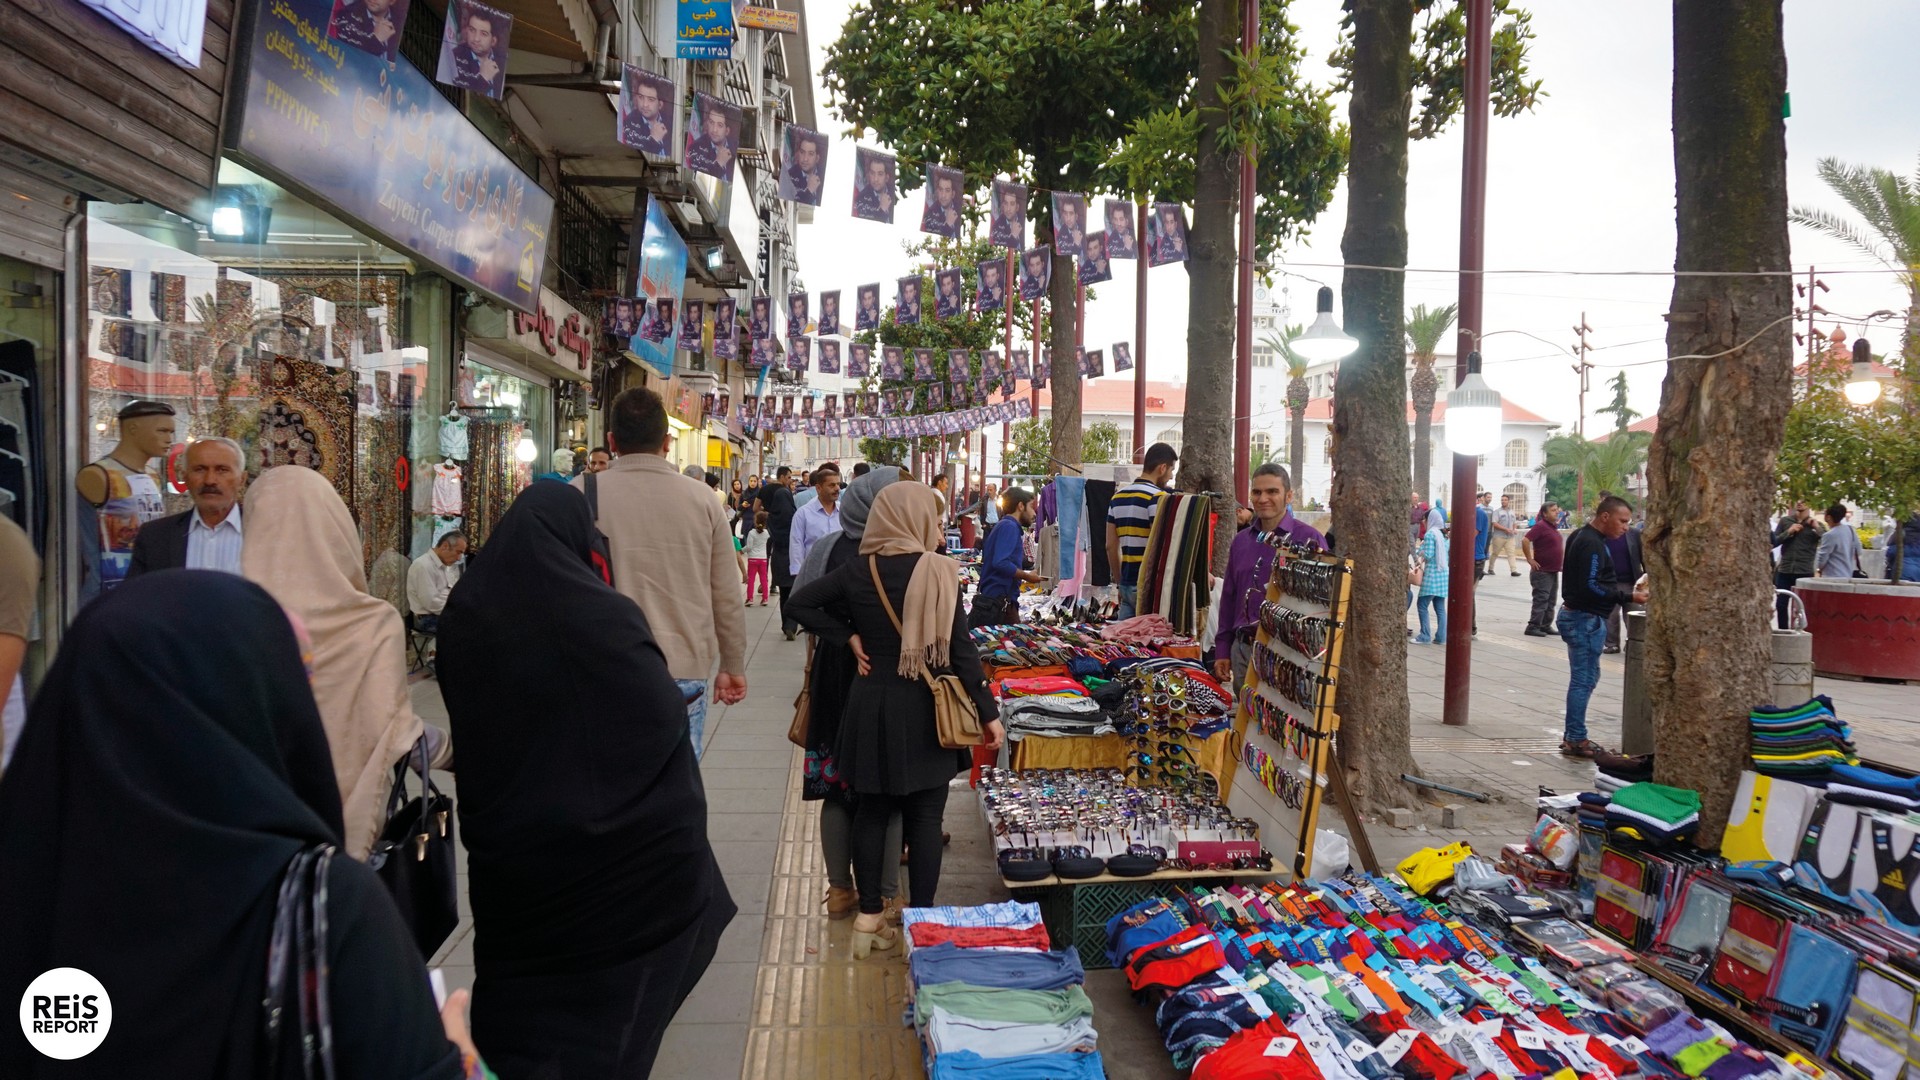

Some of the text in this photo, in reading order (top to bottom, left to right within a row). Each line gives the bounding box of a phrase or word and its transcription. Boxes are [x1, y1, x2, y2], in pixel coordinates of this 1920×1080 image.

[692, 8, 716, 20] طبی
[705, 25, 730, 38] دکتر
[379, 180, 420, 222] Zayeni
[421, 208, 454, 249] Carpet
